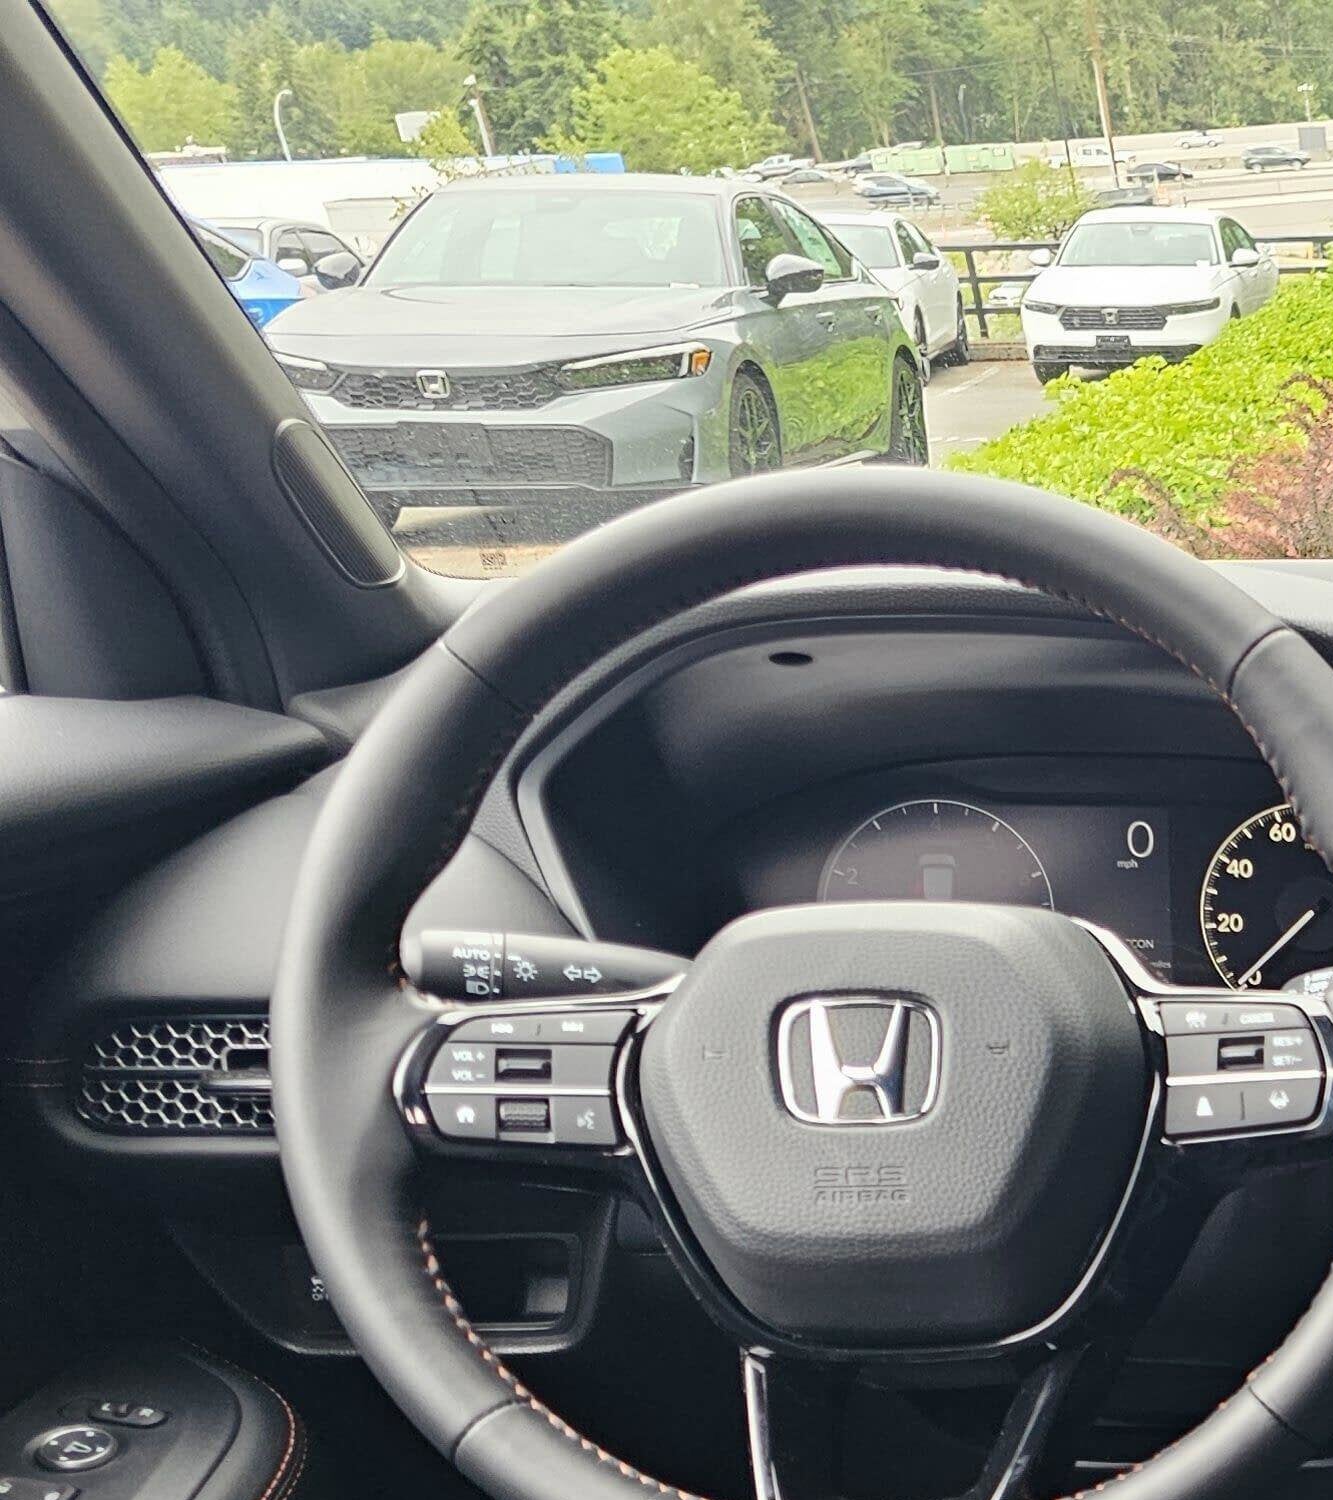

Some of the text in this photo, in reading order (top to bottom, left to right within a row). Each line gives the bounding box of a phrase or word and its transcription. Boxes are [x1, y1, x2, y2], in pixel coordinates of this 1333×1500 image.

[1127, 820, 1155, 858] 0
[1268, 822, 1297, 843] 60
[1117, 859, 1139, 869] mph
[1226, 858, 1254, 879] 40
[847, 867, 859, 886] 2
[1216, 913, 1244, 933] 20
[452, 947, 491, 961] AUTO
[453, 1051, 475, 1062] VOL
[452, 1070, 474, 1081] VOL
